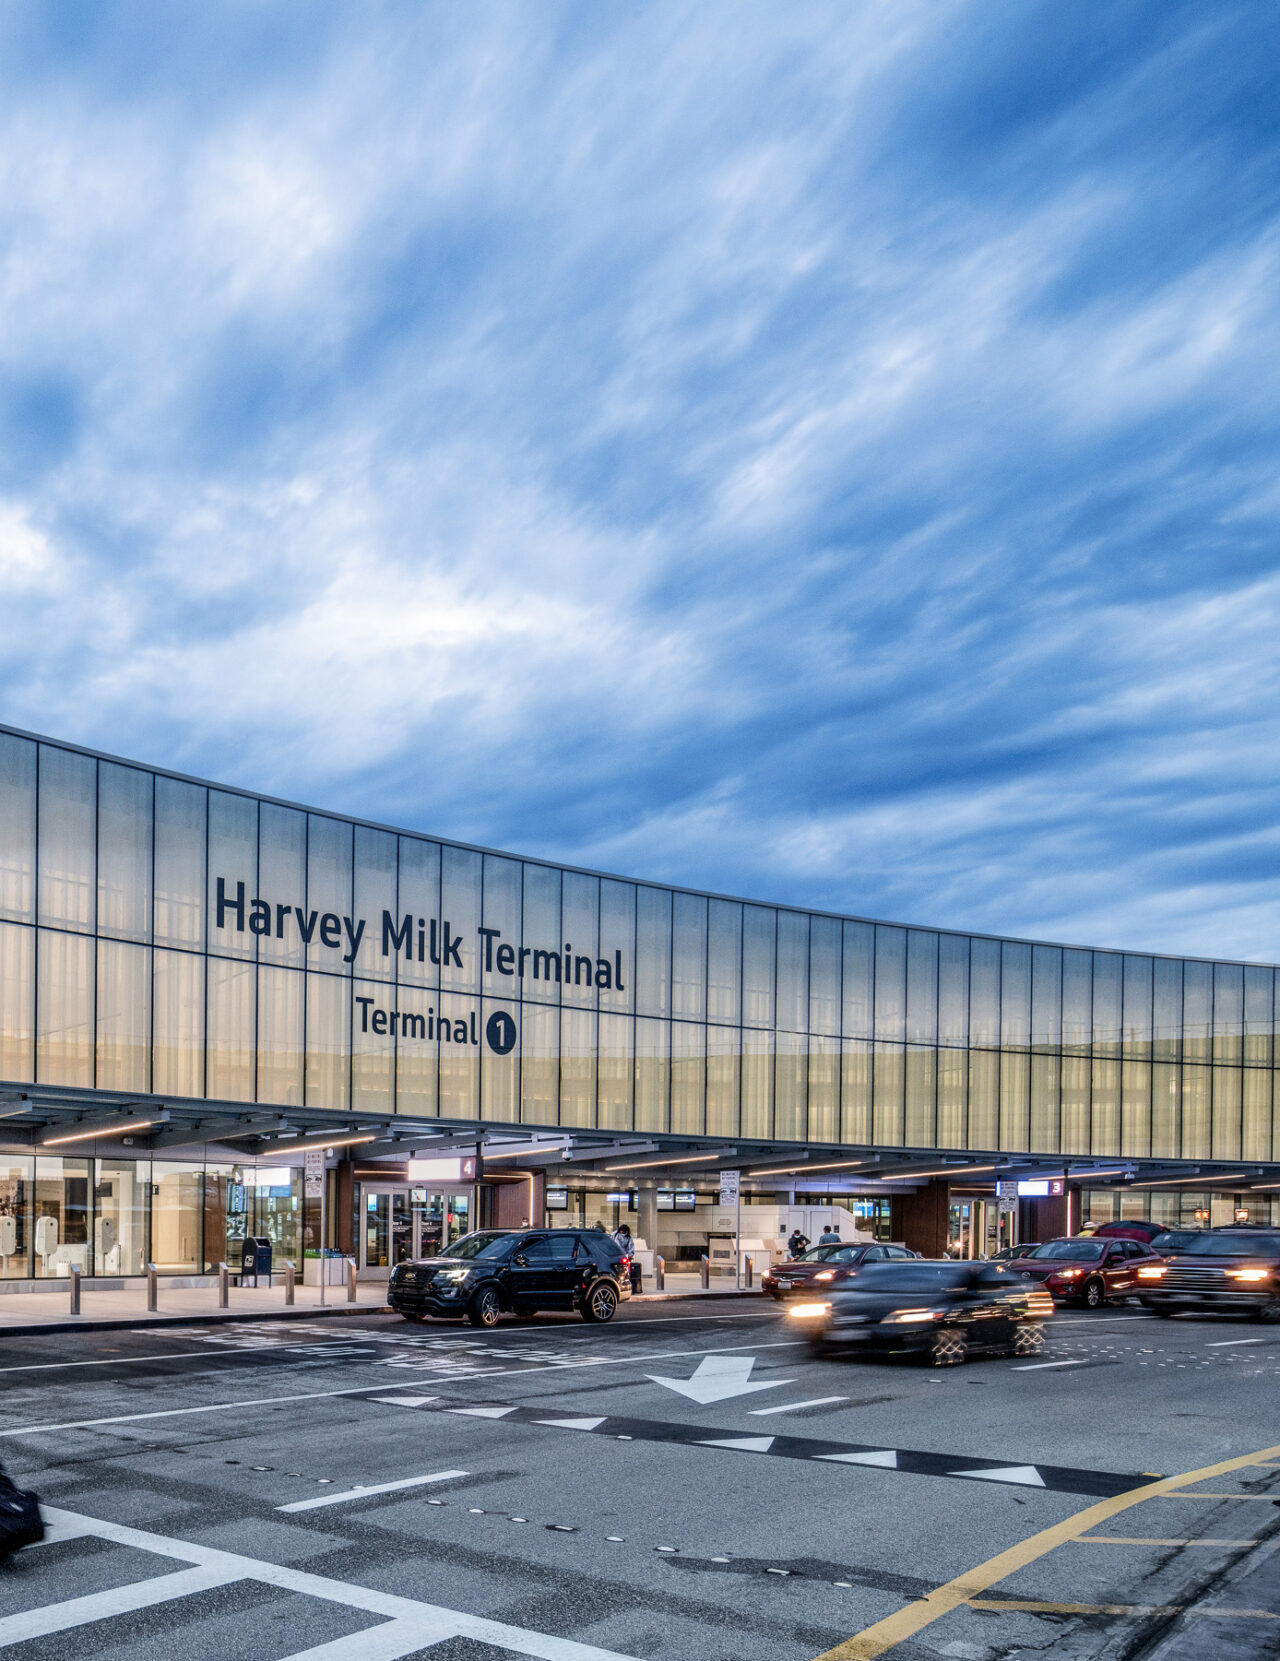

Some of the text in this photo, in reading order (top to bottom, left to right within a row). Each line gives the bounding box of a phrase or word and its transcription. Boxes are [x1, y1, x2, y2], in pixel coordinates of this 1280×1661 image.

[216, 877, 625, 991] Harvey Milk Terminal
[355, 996, 478, 1045] Terminal
[463, 1160, 472, 1175] 4
[1052, 1182, 1061, 1193] 3
[284, 1346, 506, 1375] PICK UP
[465, 1348, 612, 1365] DROP
